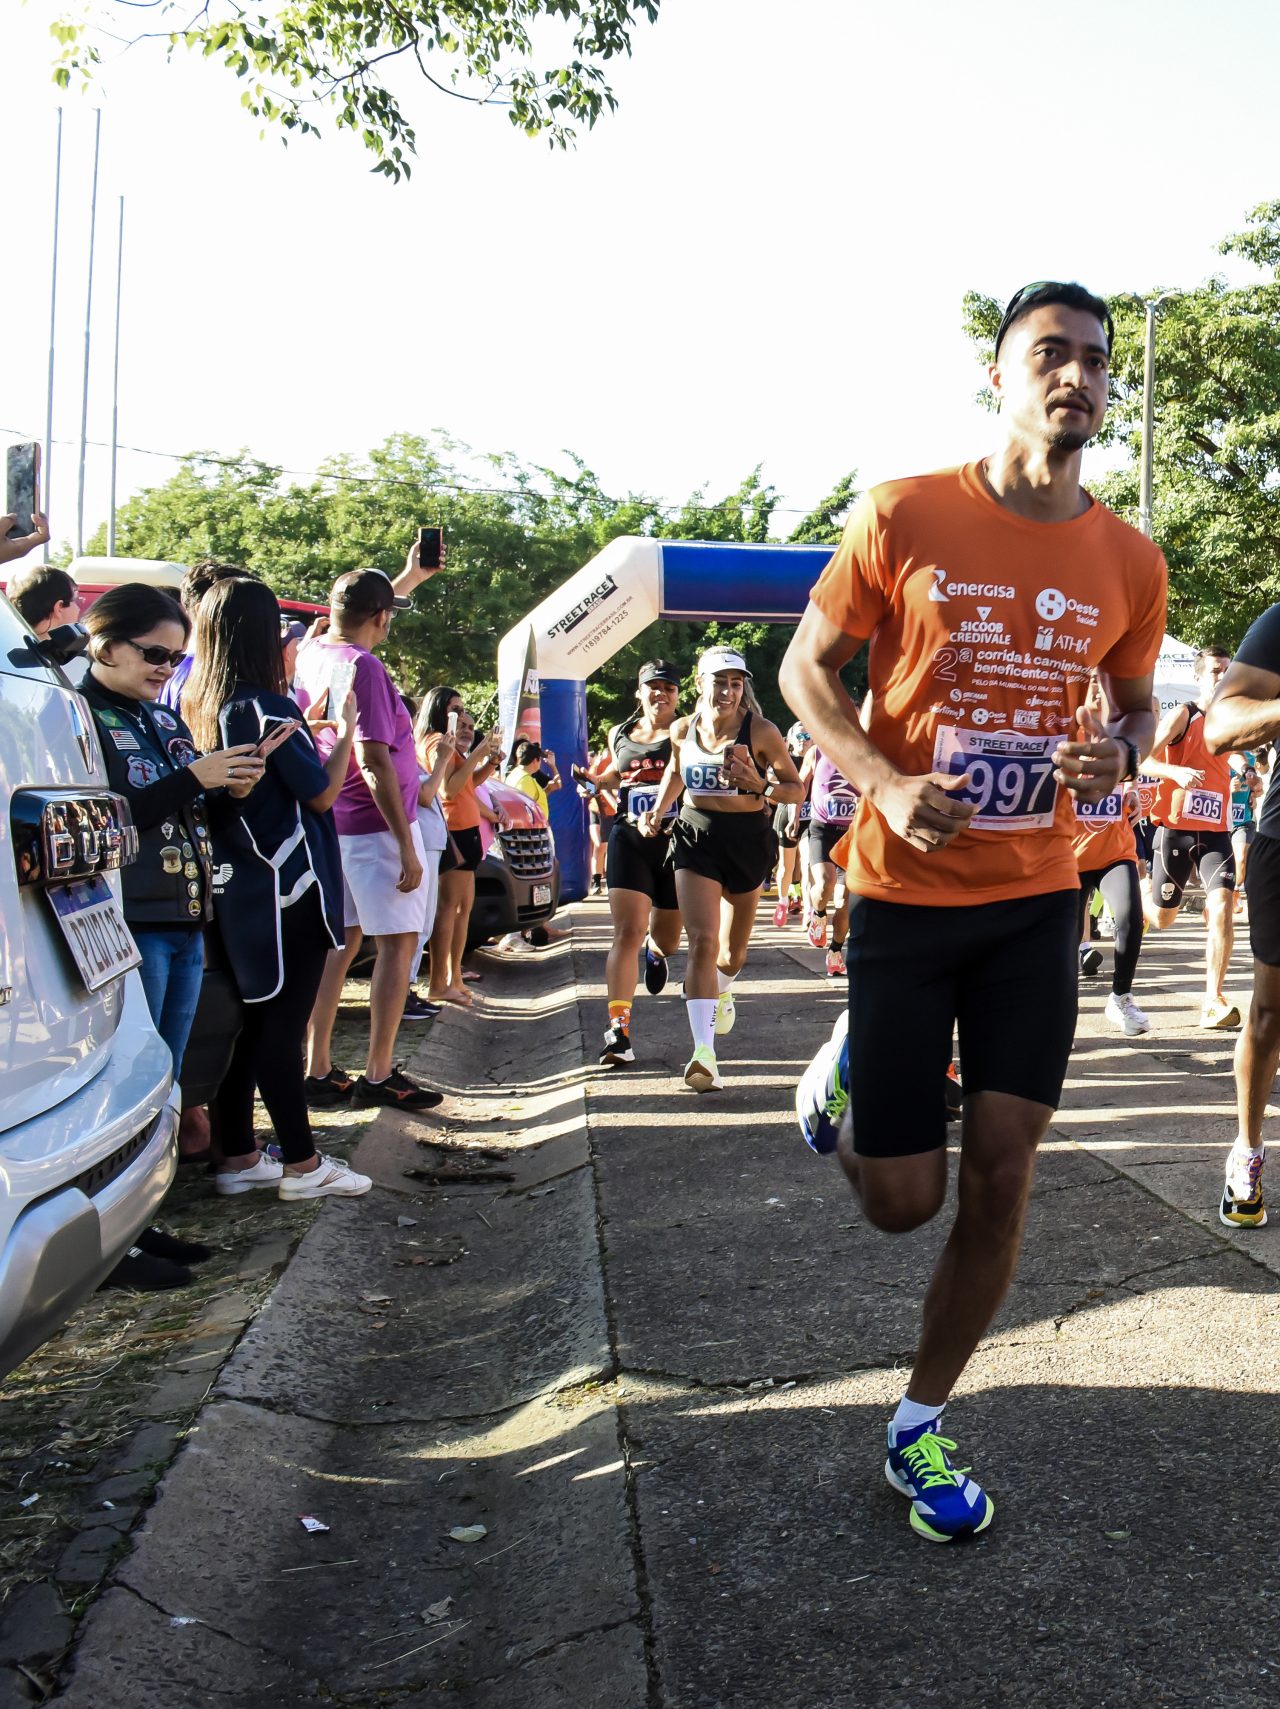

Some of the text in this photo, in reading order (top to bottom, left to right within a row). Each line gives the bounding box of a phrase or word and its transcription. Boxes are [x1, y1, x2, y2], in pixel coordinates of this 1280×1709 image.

[547, 581, 610, 639] STREET RACE
[1066, 598, 1100, 617] Oeste
[582, 610, 629, 653] (18)9784-1225
[960, 621, 1004, 633] SICOOB
[949, 631, 1012, 645] CREDIVALE
[976, 648, 1022, 664] corrida
[1023, 652, 1032, 665] &
[973, 662, 1049, 680] beneficente
[969, 737, 1043, 751] STREET RACE
[961, 760, 1053, 814] 997
[1192, 797, 1220, 818] 905
